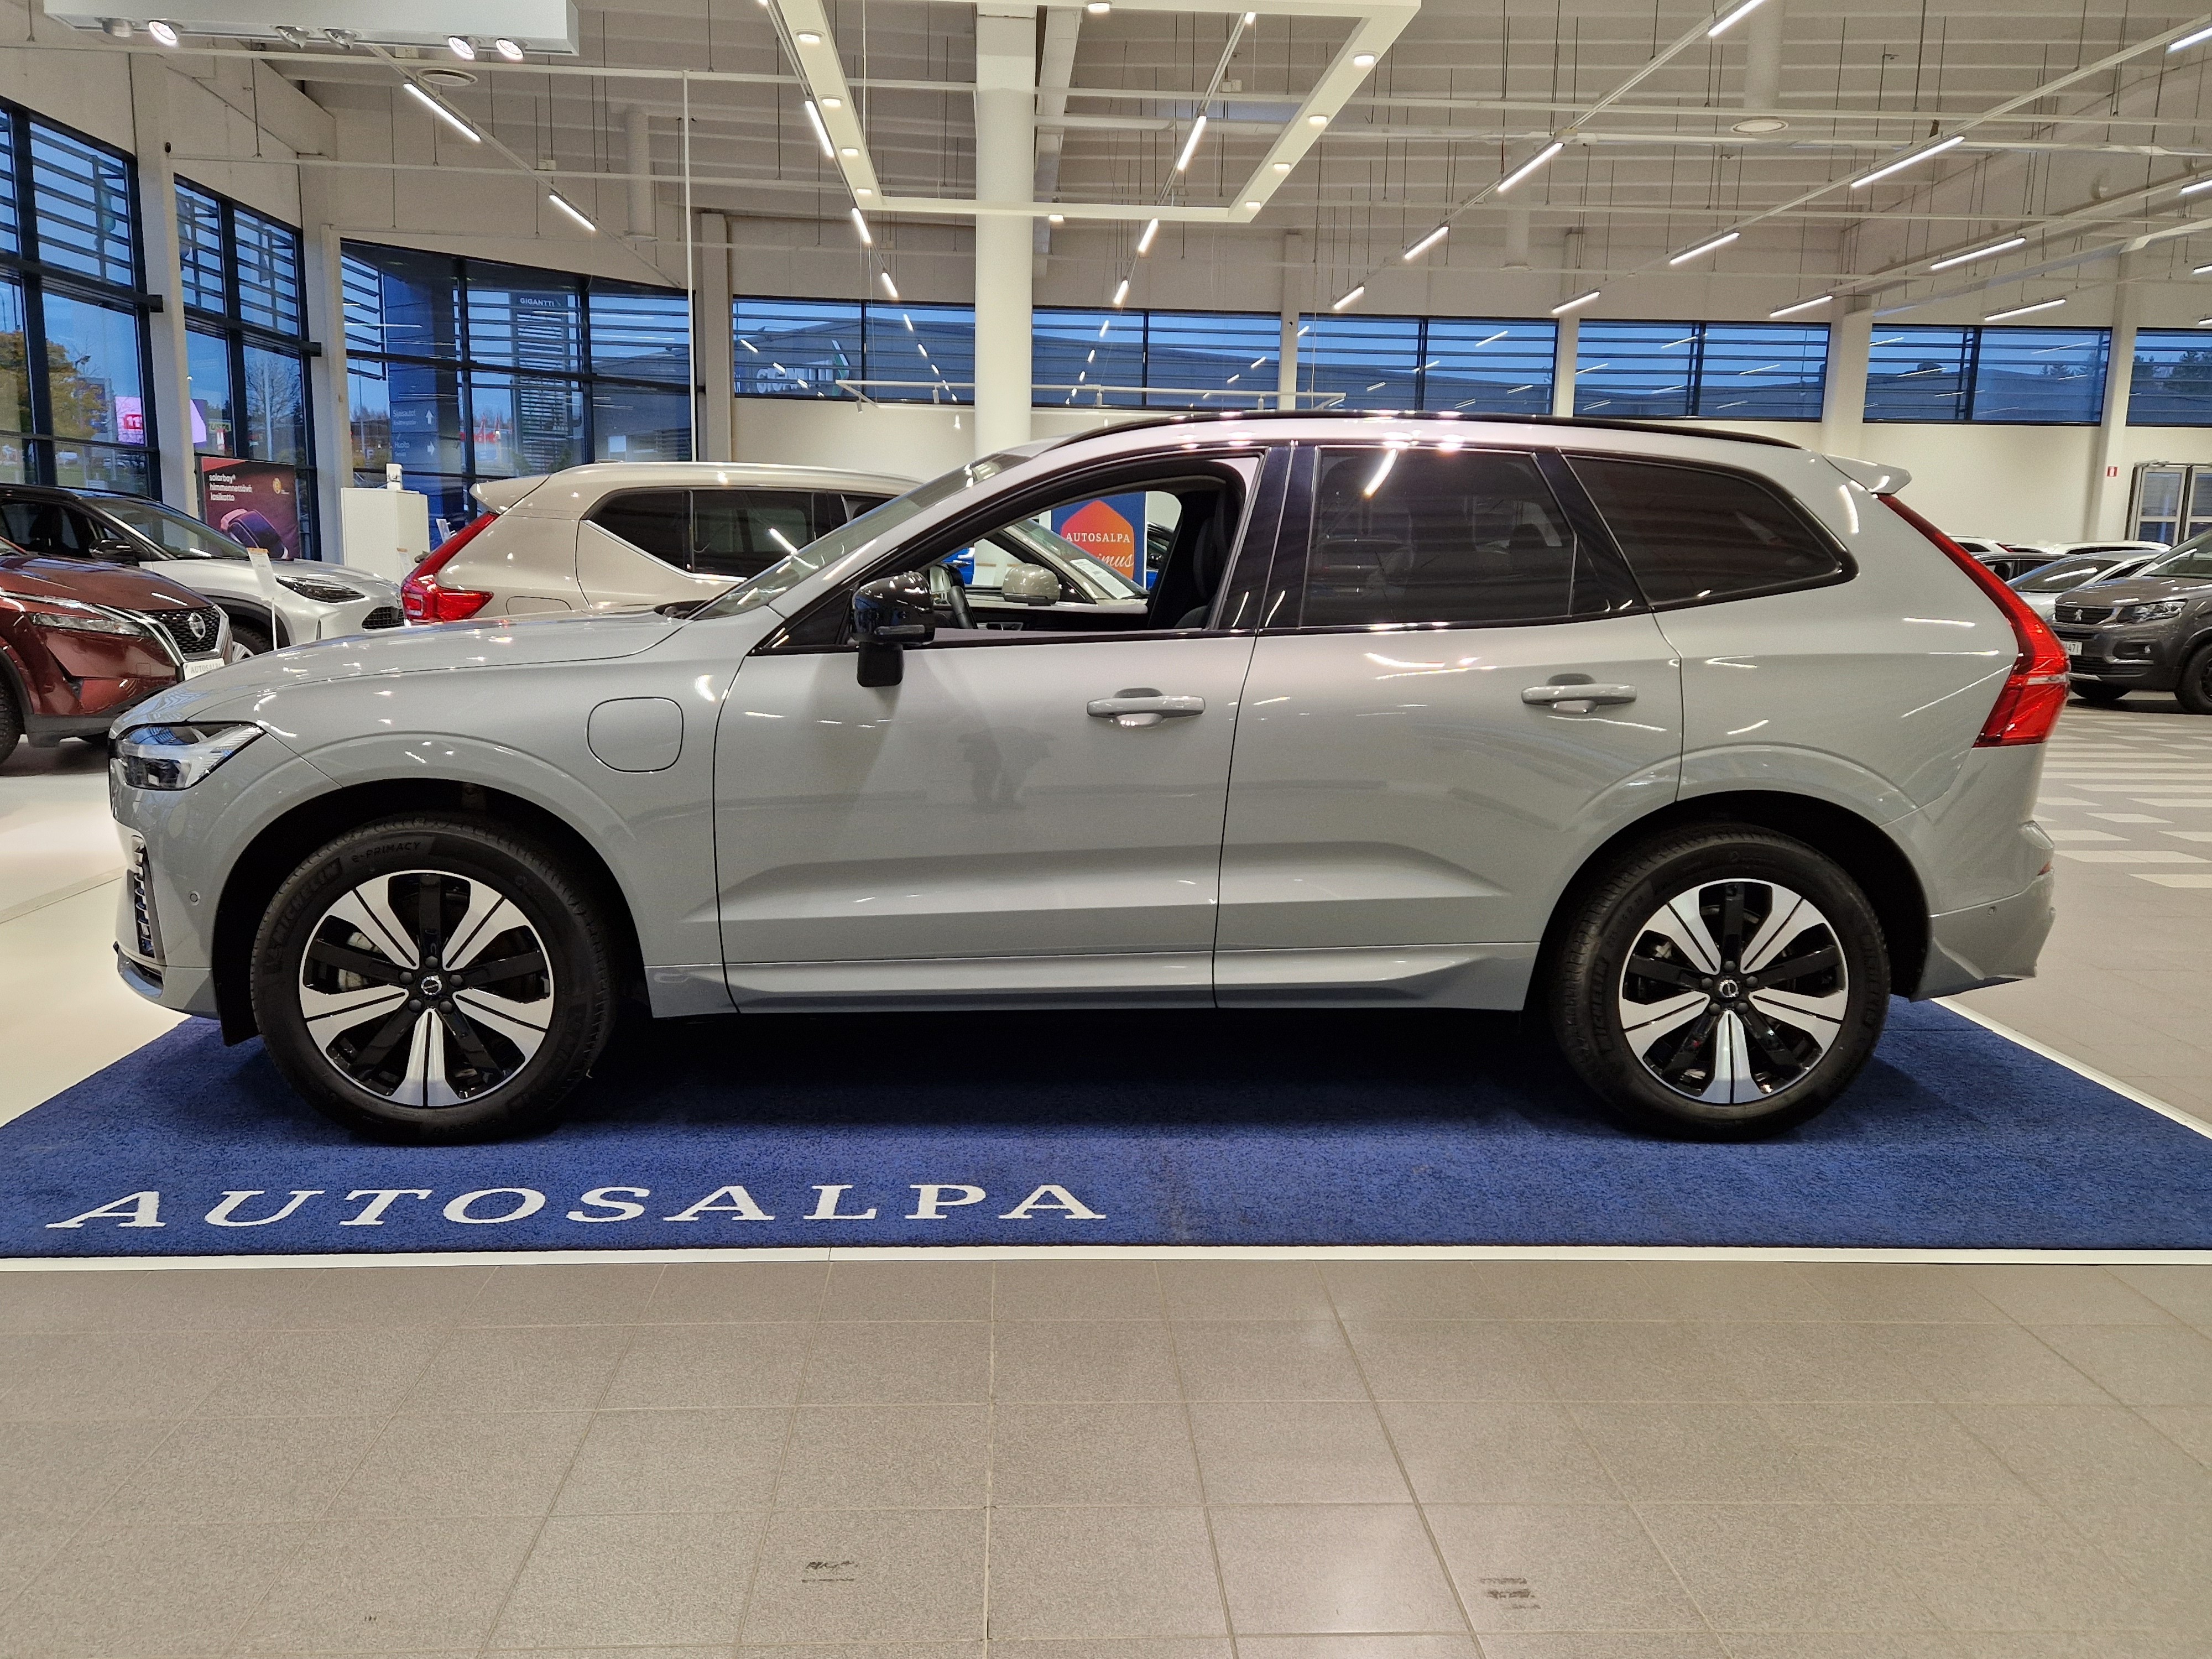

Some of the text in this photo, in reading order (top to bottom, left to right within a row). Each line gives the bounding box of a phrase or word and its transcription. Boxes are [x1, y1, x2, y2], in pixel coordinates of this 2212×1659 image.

[520, 297, 554, 307] GIGANTTI
[1066, 533, 1131, 543] AUTOSALPA
[45, 1183, 1106, 1229] AUTOSALPA
